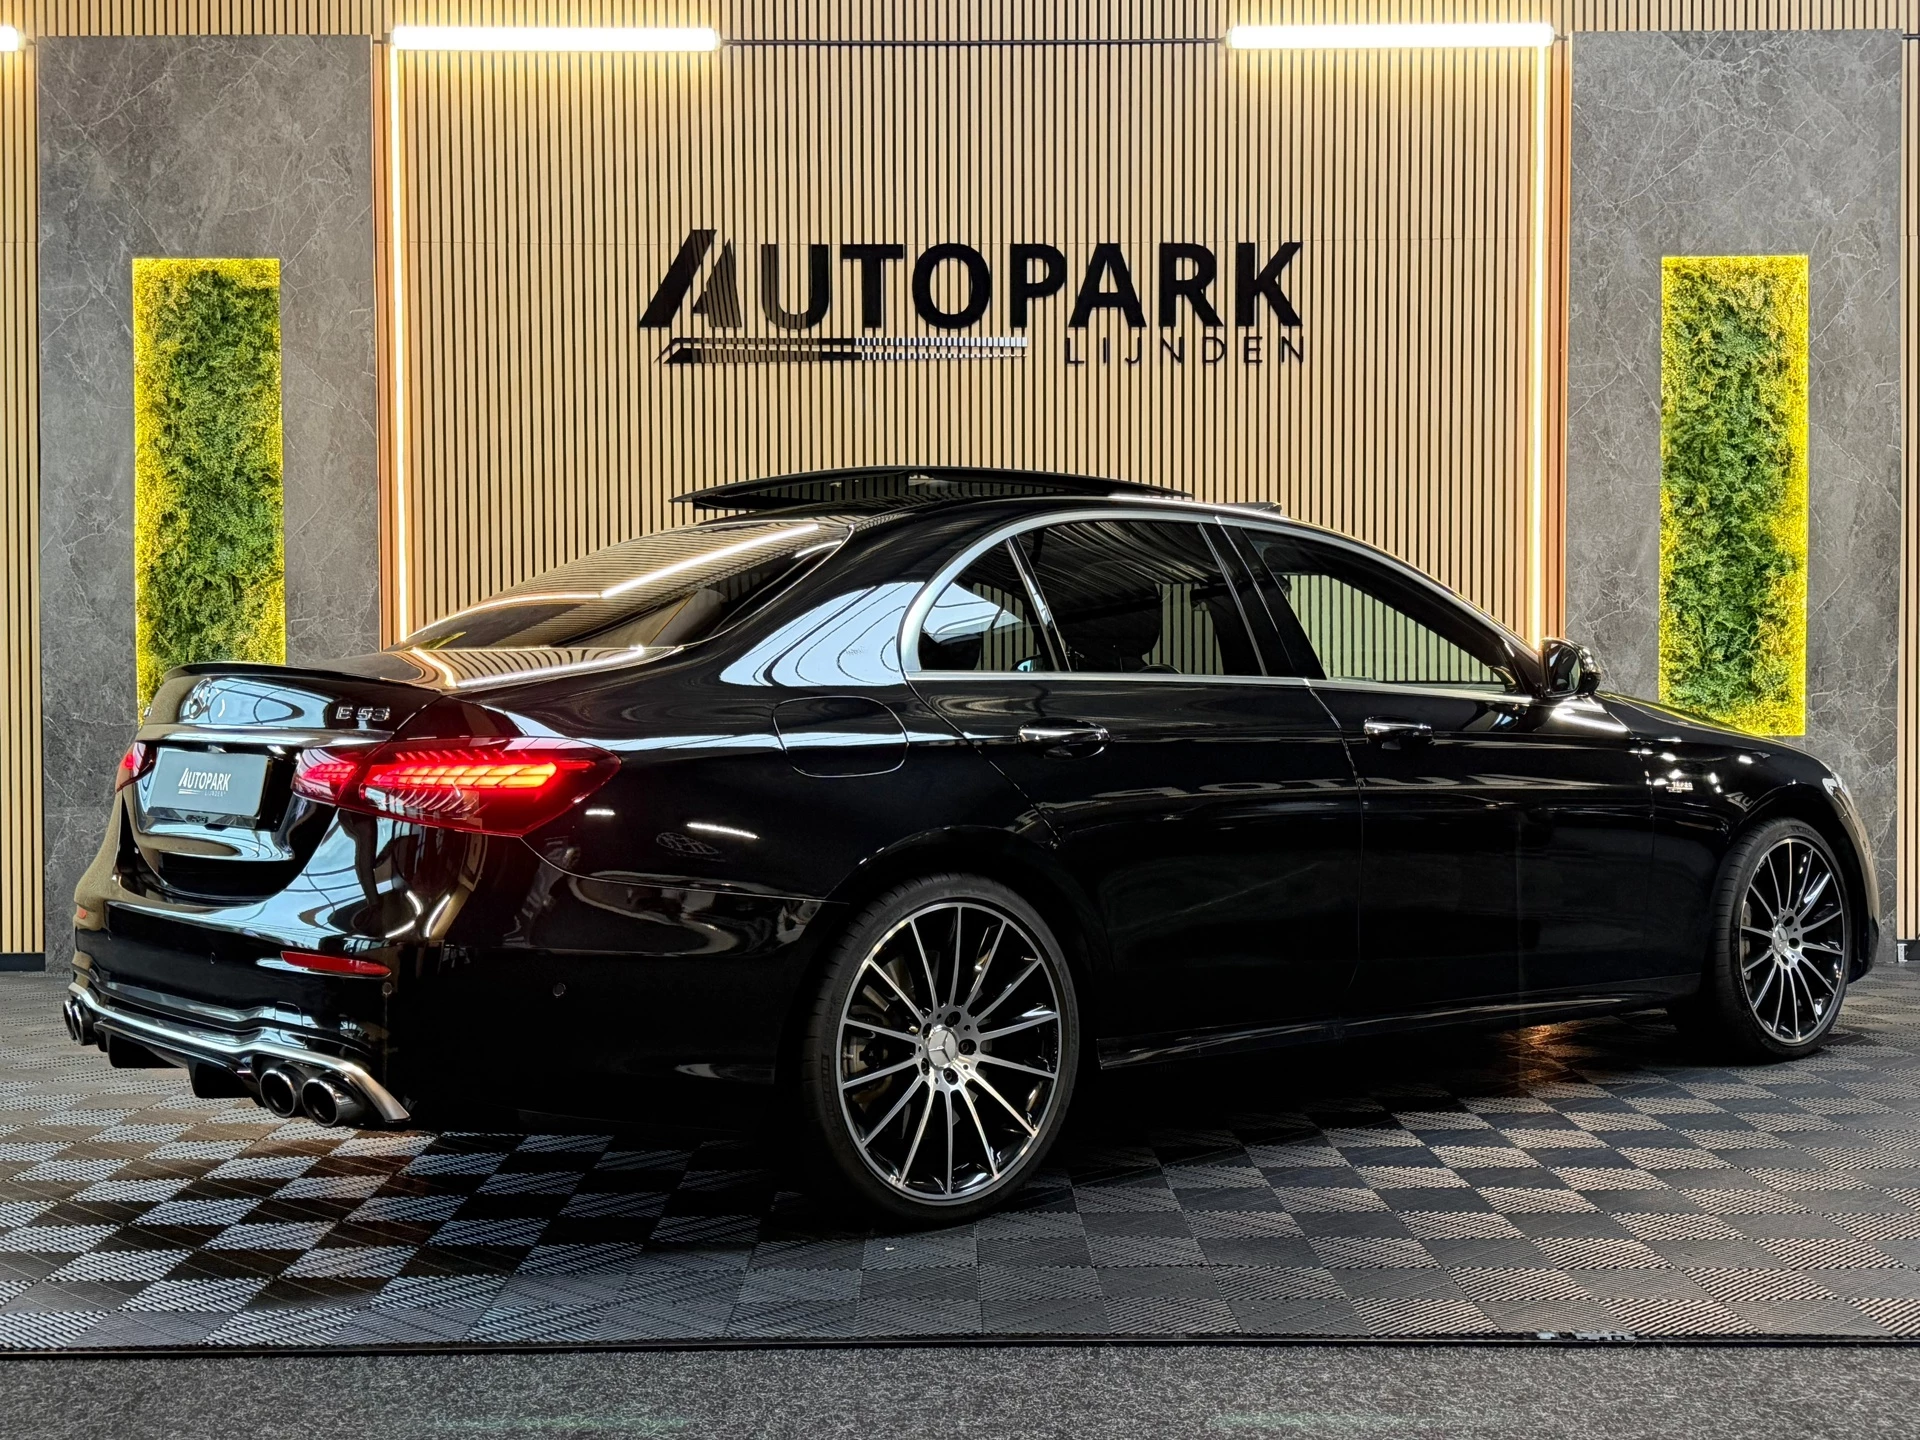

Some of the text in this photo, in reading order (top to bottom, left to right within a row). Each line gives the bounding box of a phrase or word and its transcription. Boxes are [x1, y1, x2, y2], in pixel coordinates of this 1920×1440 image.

[639, 229, 1303, 330] AUTOPARK
[1065, 336, 1304, 365] LIJNDEN
[178, 767, 231, 791] AUTOPARK
